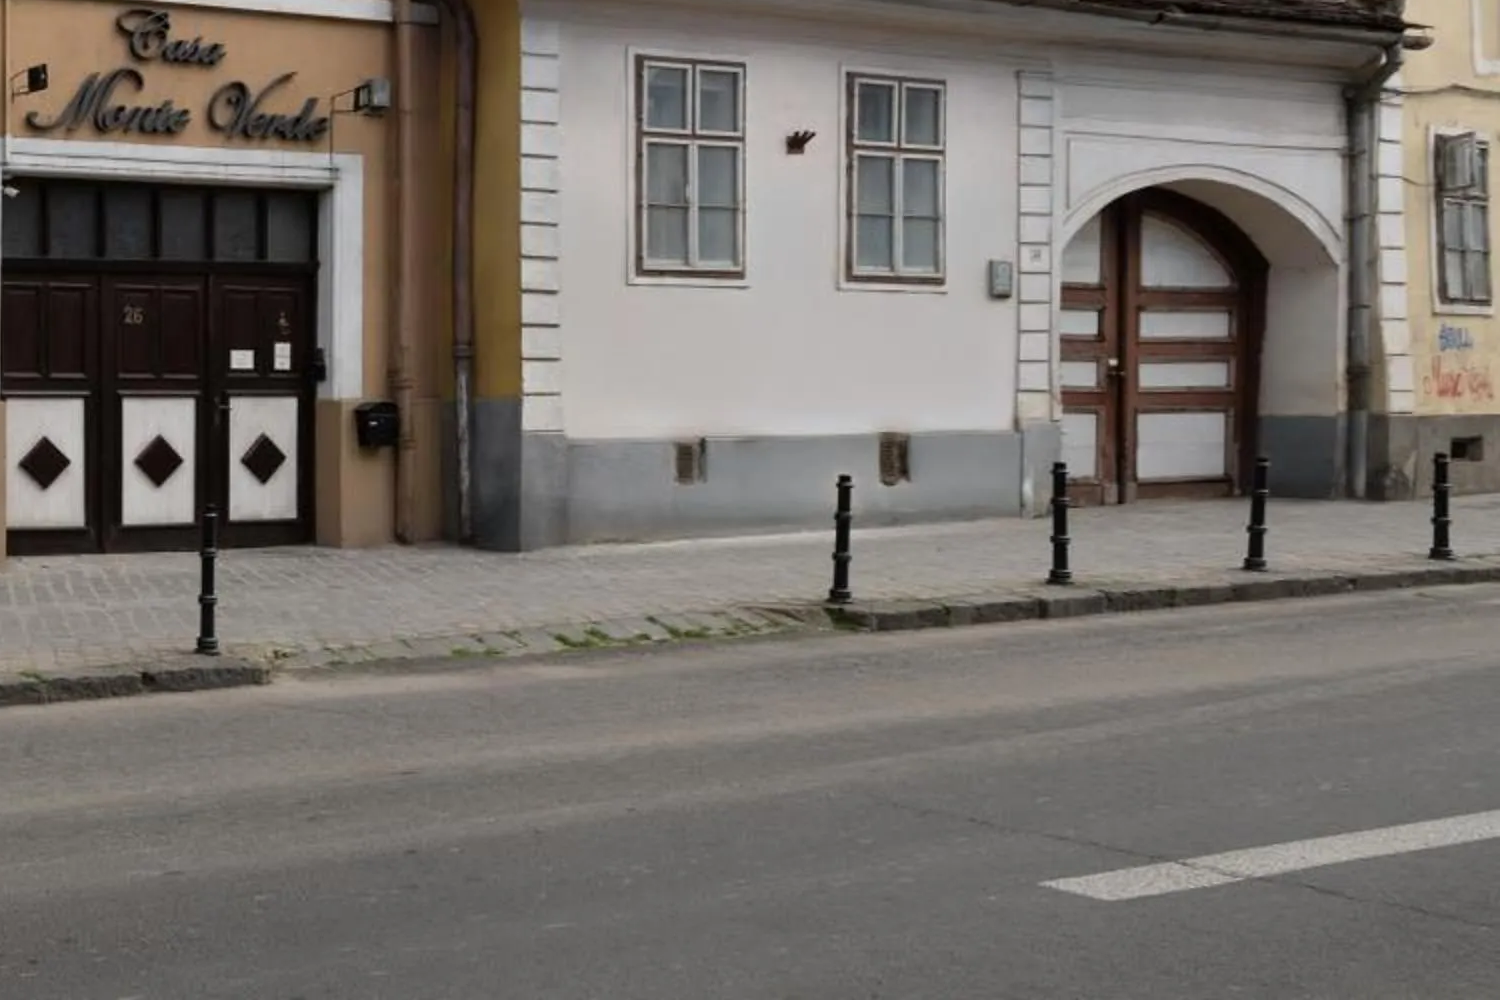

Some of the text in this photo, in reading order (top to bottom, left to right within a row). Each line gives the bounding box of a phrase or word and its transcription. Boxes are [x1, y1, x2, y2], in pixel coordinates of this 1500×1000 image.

[115, 8, 226, 66] Casa
[25, 69, 328, 141] Monte Verde
